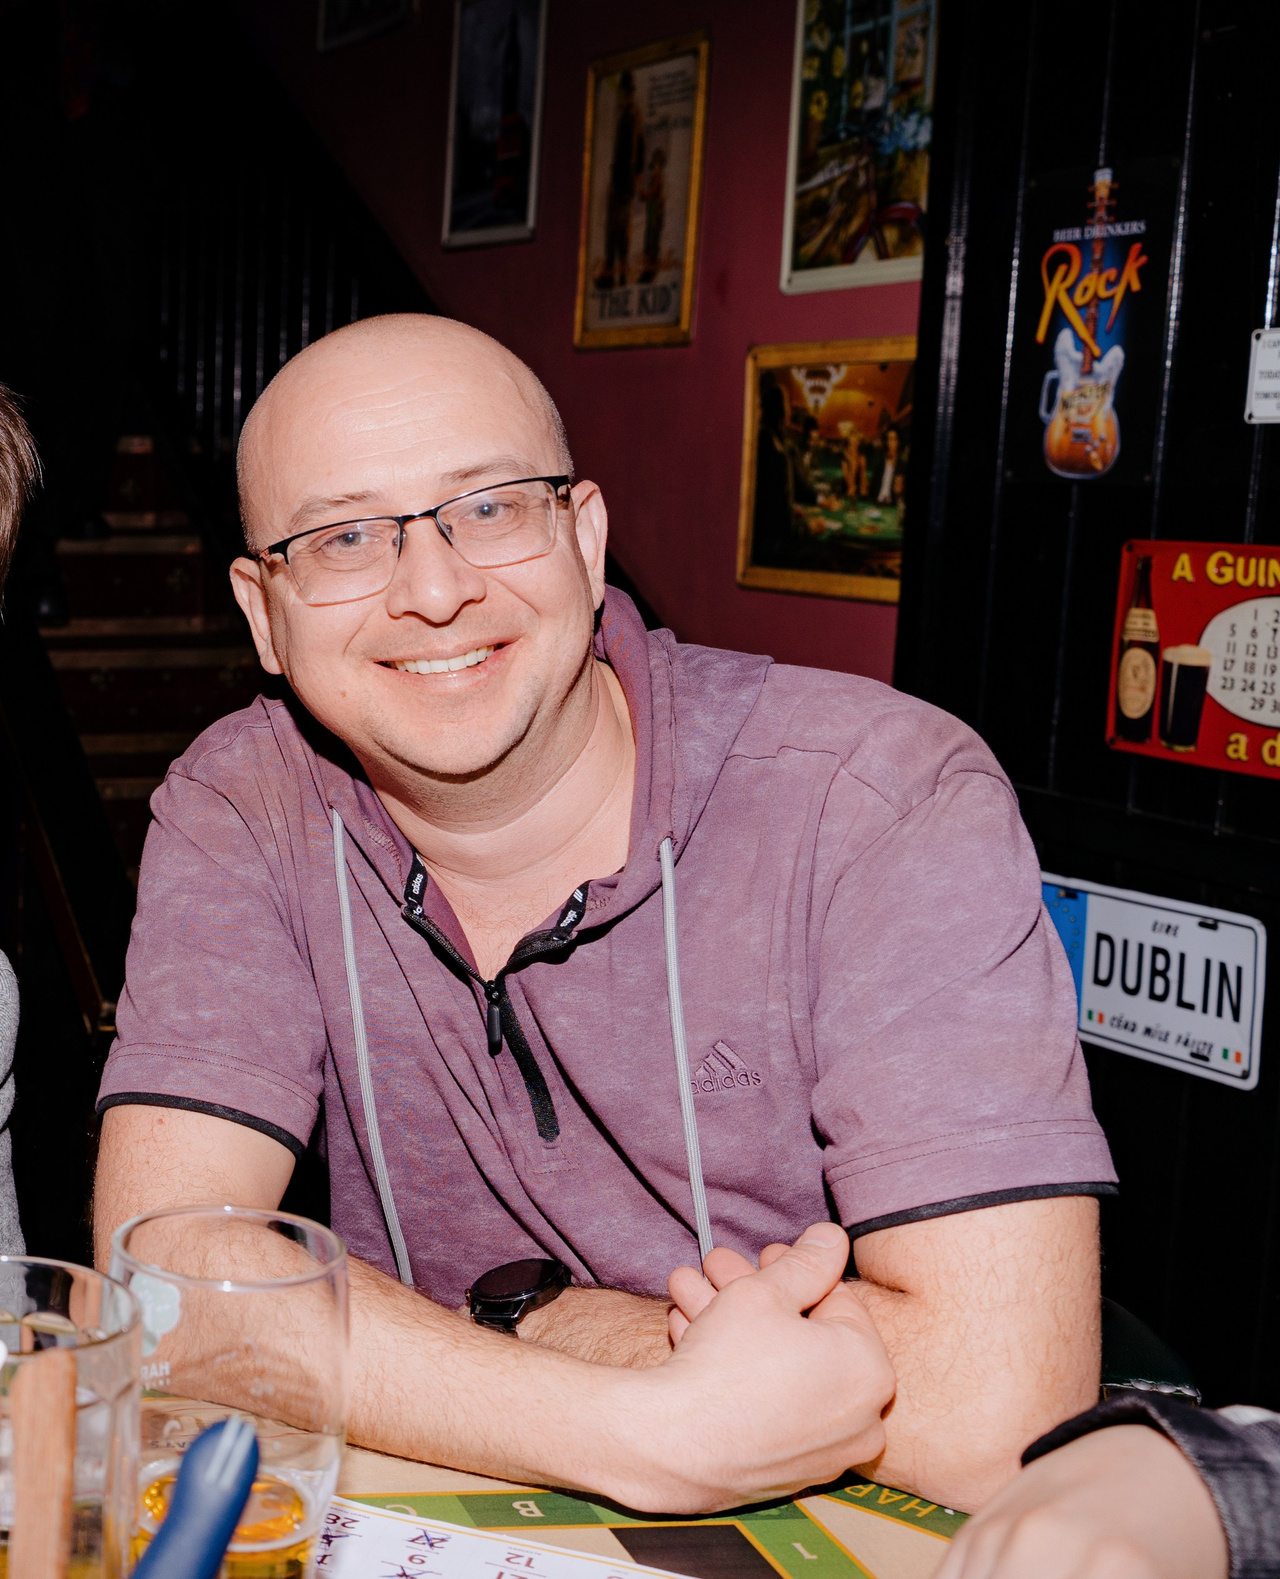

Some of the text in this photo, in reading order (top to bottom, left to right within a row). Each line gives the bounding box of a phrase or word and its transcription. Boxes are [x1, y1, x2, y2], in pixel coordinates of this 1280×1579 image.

[1053, 219, 1147, 242] BEER DRINKERS
[1034, 242, 1150, 358] Rock
[1172, 553, 1193, 583] A
[1245, 643, 1258, 658] 12
[1226, 731, 1249, 762] a
[1093, 932, 1242, 1023] DUBLIN
[690, 1071, 762, 1096] adidas
[511, 1500, 545, 1517] B
[504, 1551, 535, 1569] 12
